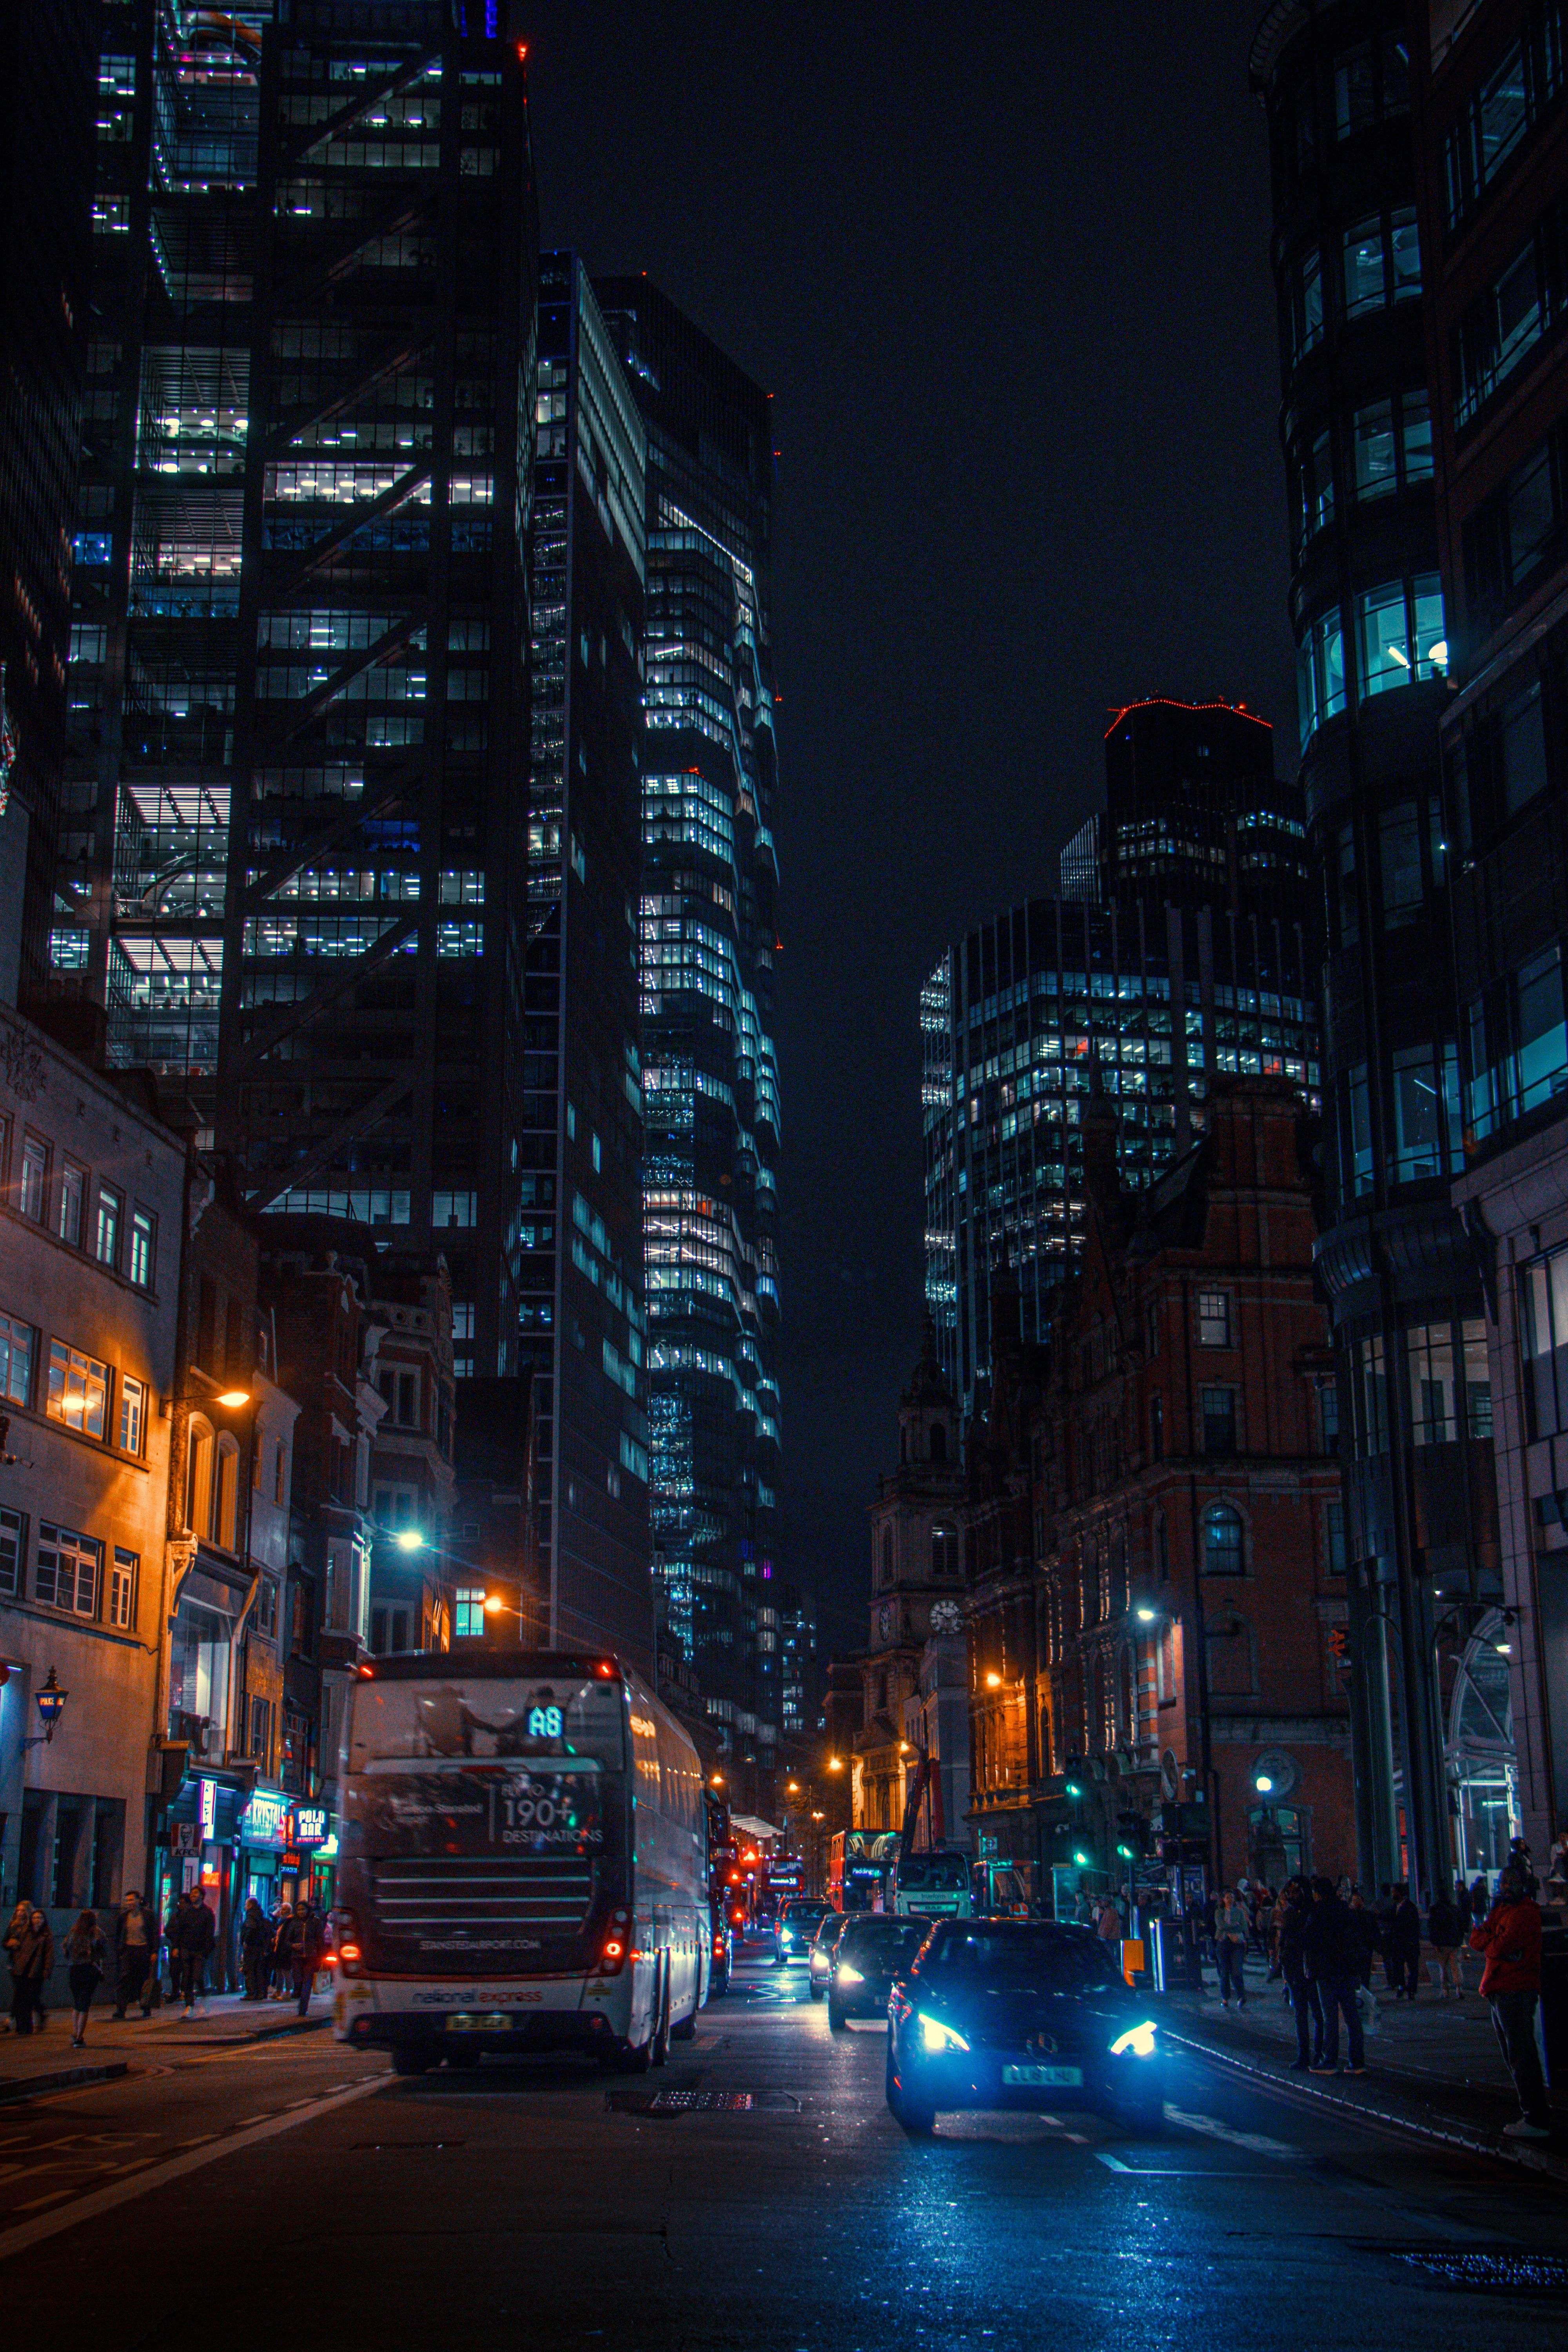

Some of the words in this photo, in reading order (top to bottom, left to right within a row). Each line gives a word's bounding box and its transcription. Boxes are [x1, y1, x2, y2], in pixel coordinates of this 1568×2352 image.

[253, 1798, 286, 1830] KRYSTALS
[299, 1810, 325, 1823] POLO
[504, 1800, 572, 1826] 190+
[300, 1823, 321, 1836] BAR
[503, 1830, 604, 1842] DESTINATIONS
[413, 1988, 475, 2003] national
[478, 1991, 543, 2006] express
